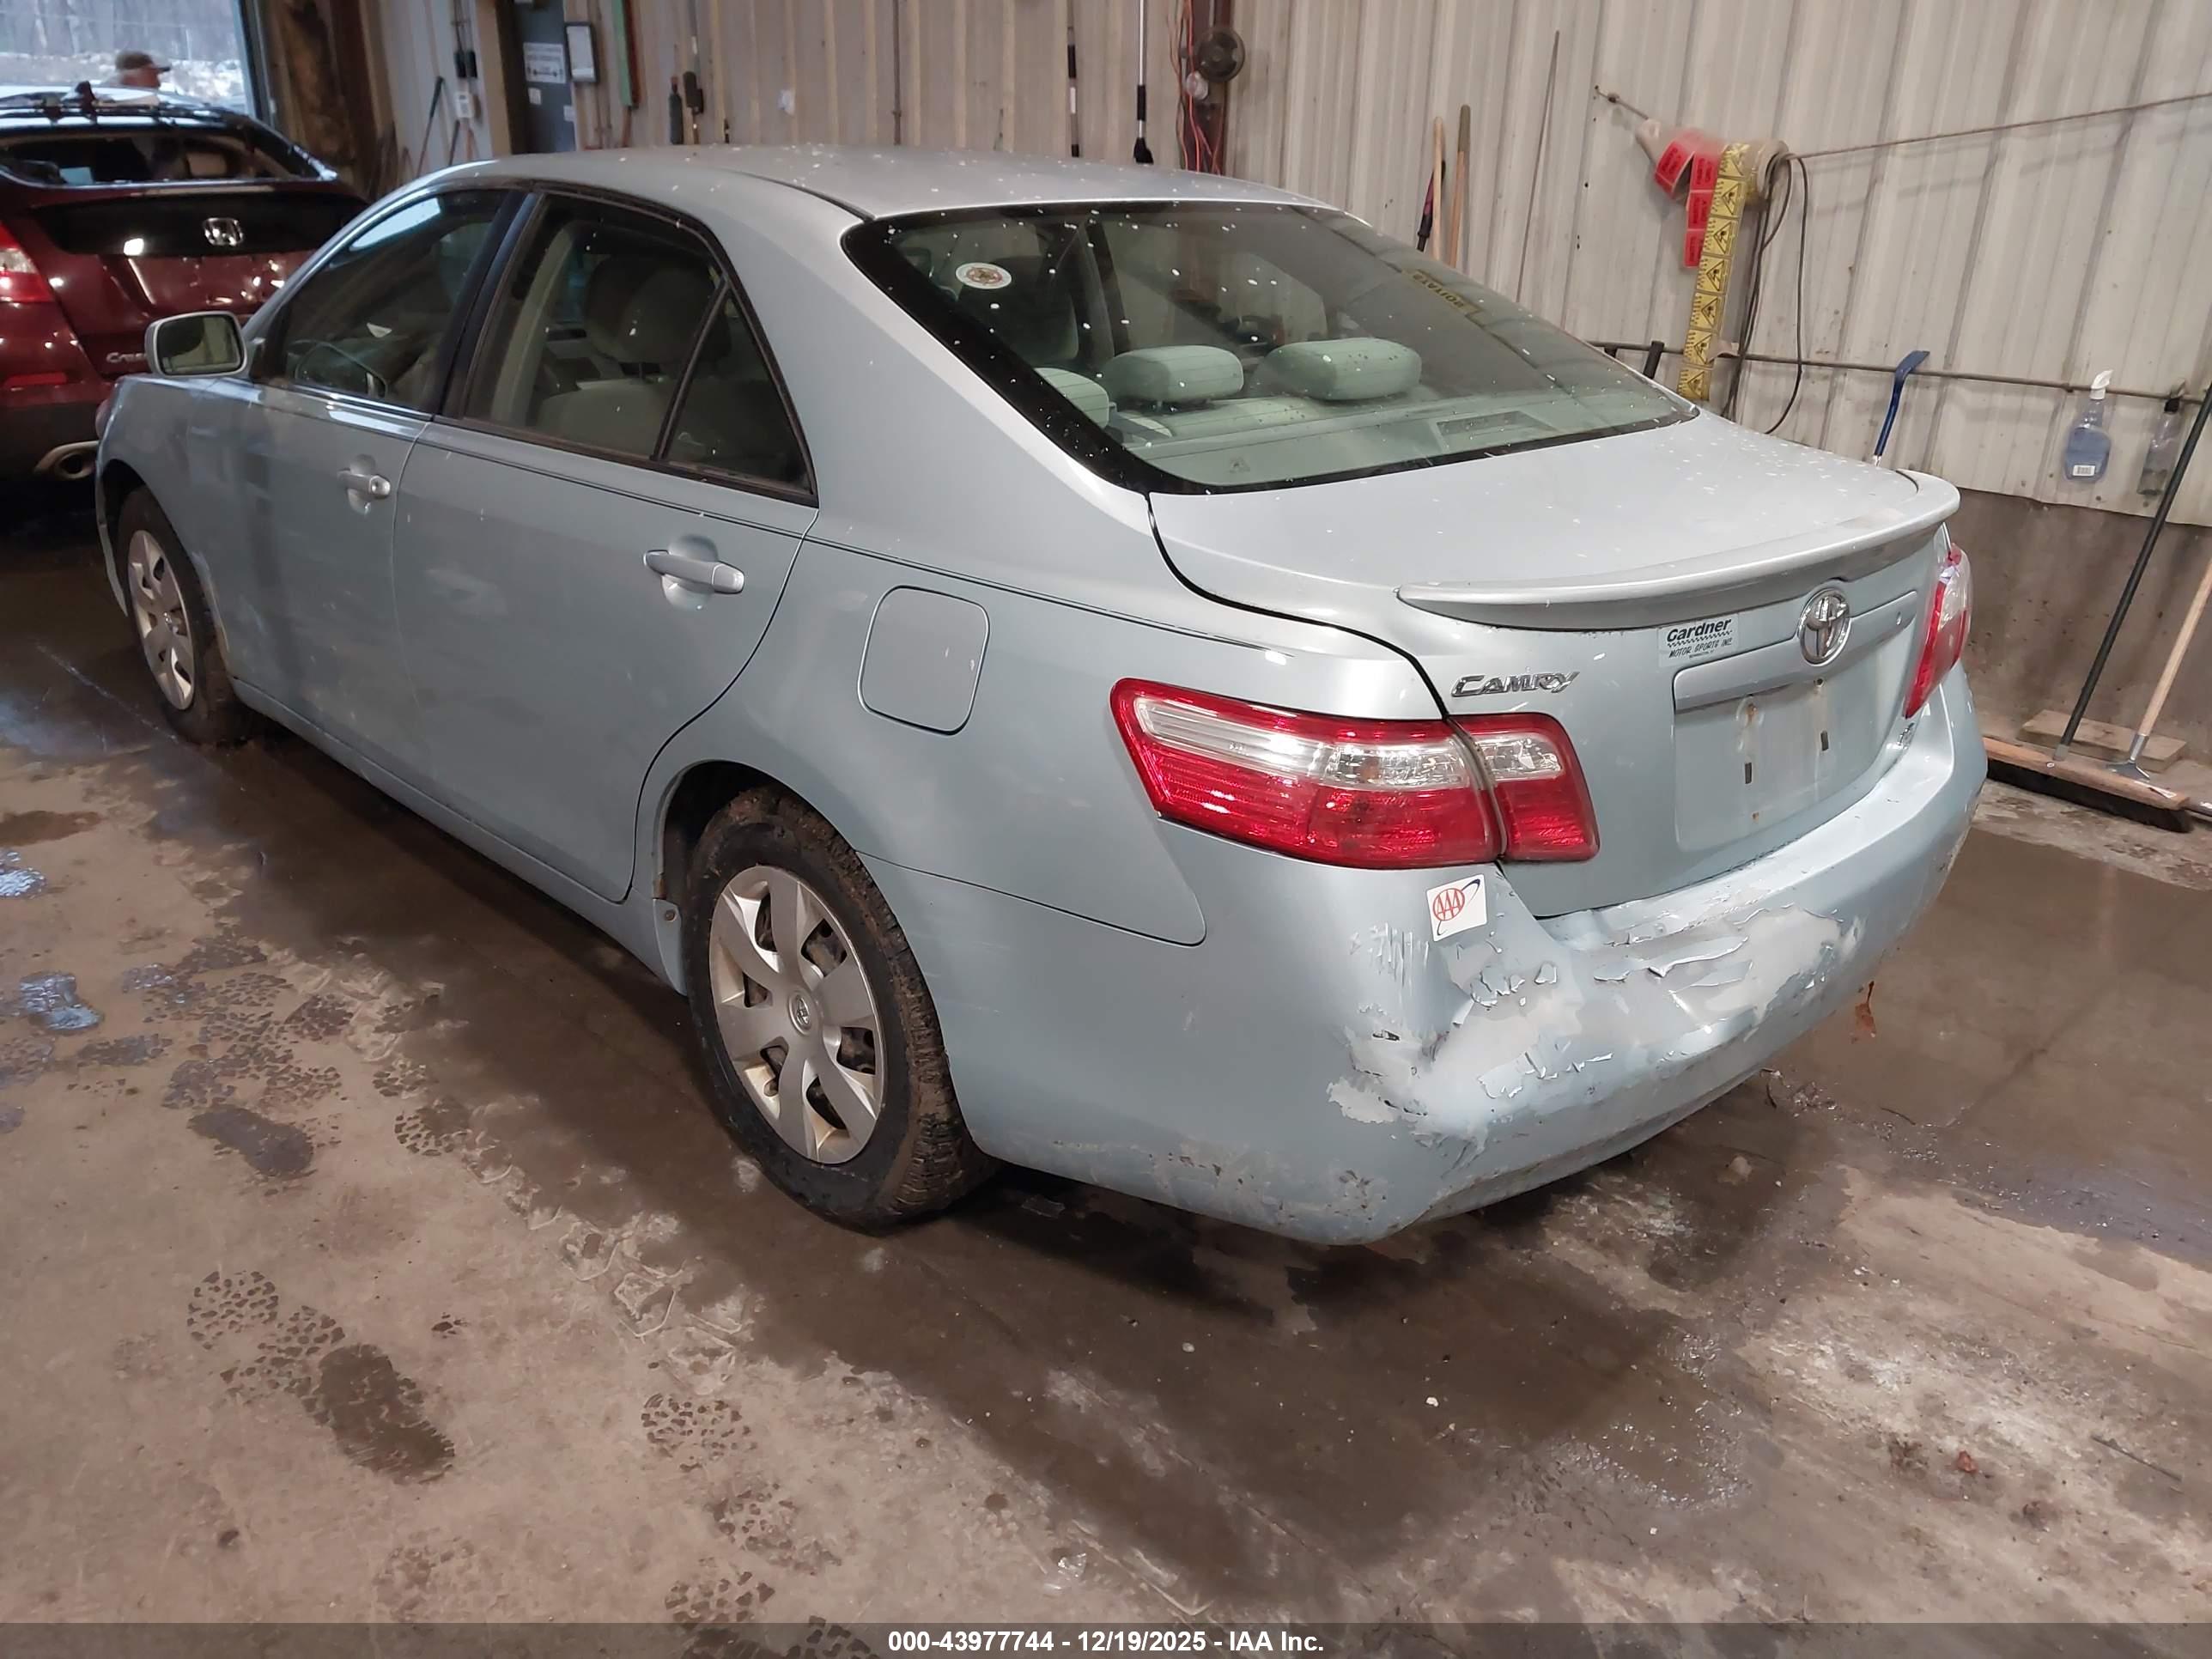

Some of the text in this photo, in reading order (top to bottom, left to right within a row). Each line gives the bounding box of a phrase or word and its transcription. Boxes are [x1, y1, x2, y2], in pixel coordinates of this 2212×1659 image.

[1667, 619, 1732, 641] Gardner
[1668, 645, 1692, 659] MOTOR
[1694, 639, 1720, 653] SPORTS
[1451, 672, 1580, 697] CAMRY
[1435, 888, 1463, 921] AAA
